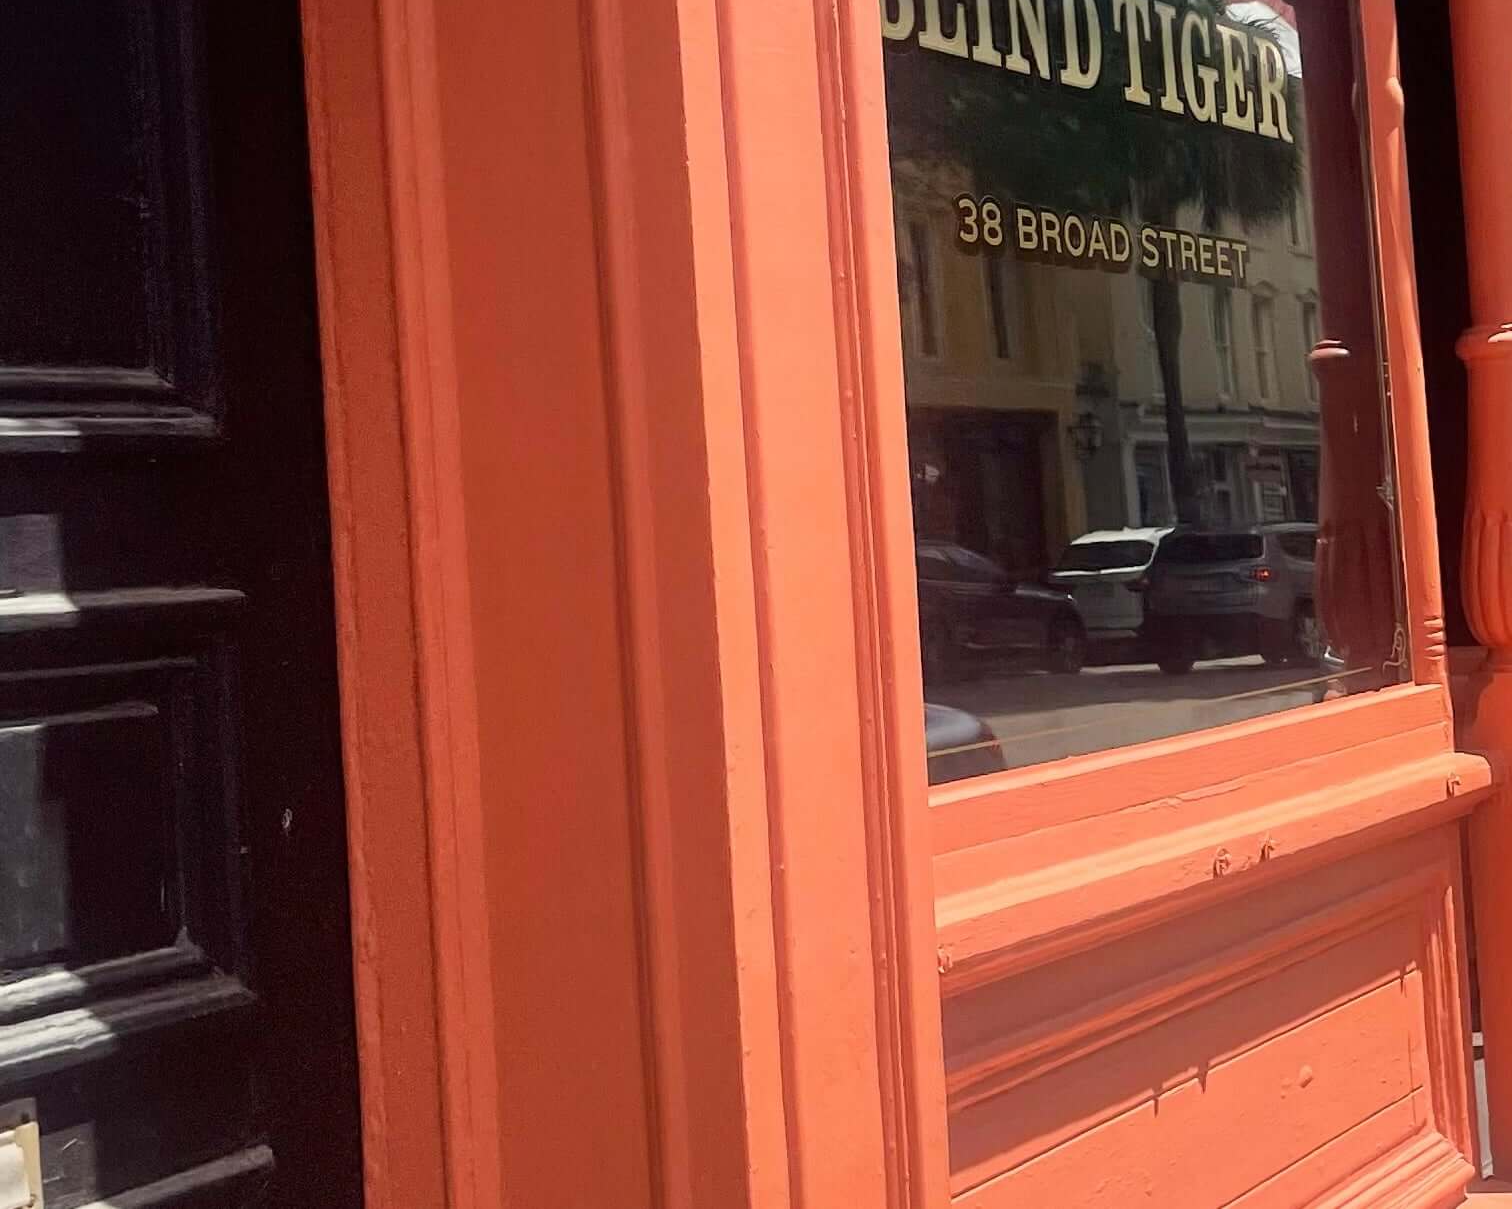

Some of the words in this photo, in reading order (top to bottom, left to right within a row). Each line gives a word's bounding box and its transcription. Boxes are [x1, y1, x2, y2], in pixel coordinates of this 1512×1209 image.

[958, 198, 1002, 246] 38
[1016, 208, 1130, 262] BROAD
[1141, 228, 1248, 279] STREET
